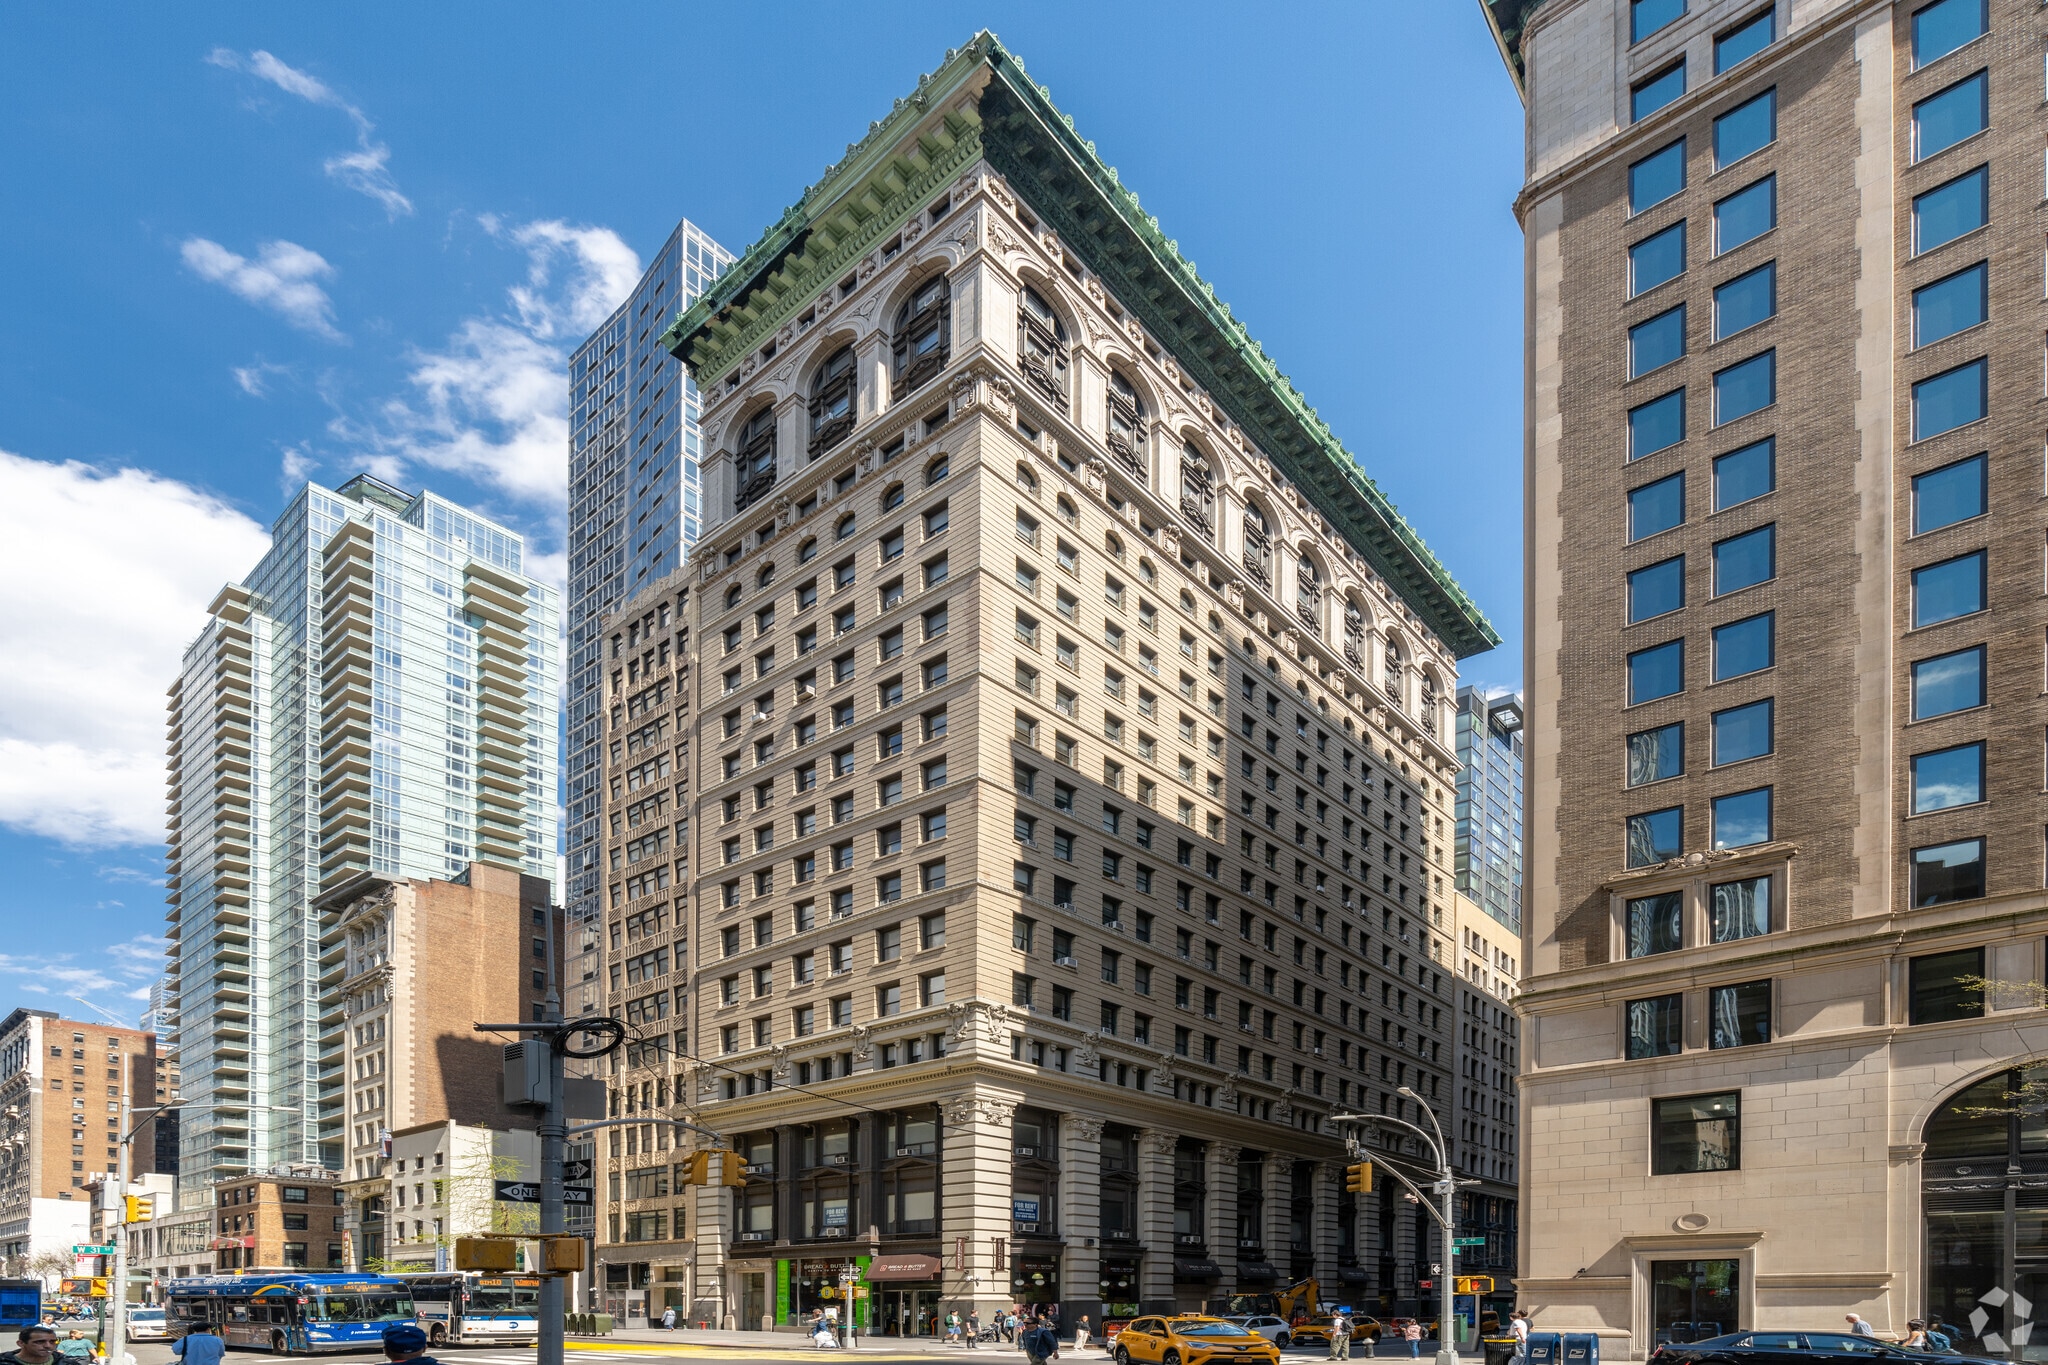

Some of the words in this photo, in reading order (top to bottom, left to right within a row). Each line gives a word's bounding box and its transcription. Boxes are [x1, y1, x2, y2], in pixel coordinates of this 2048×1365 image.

[568, 1166, 583, 1175] WAY
[511, 1187, 539, 1197] ONE
[564, 1191, 581, 1200] AY
